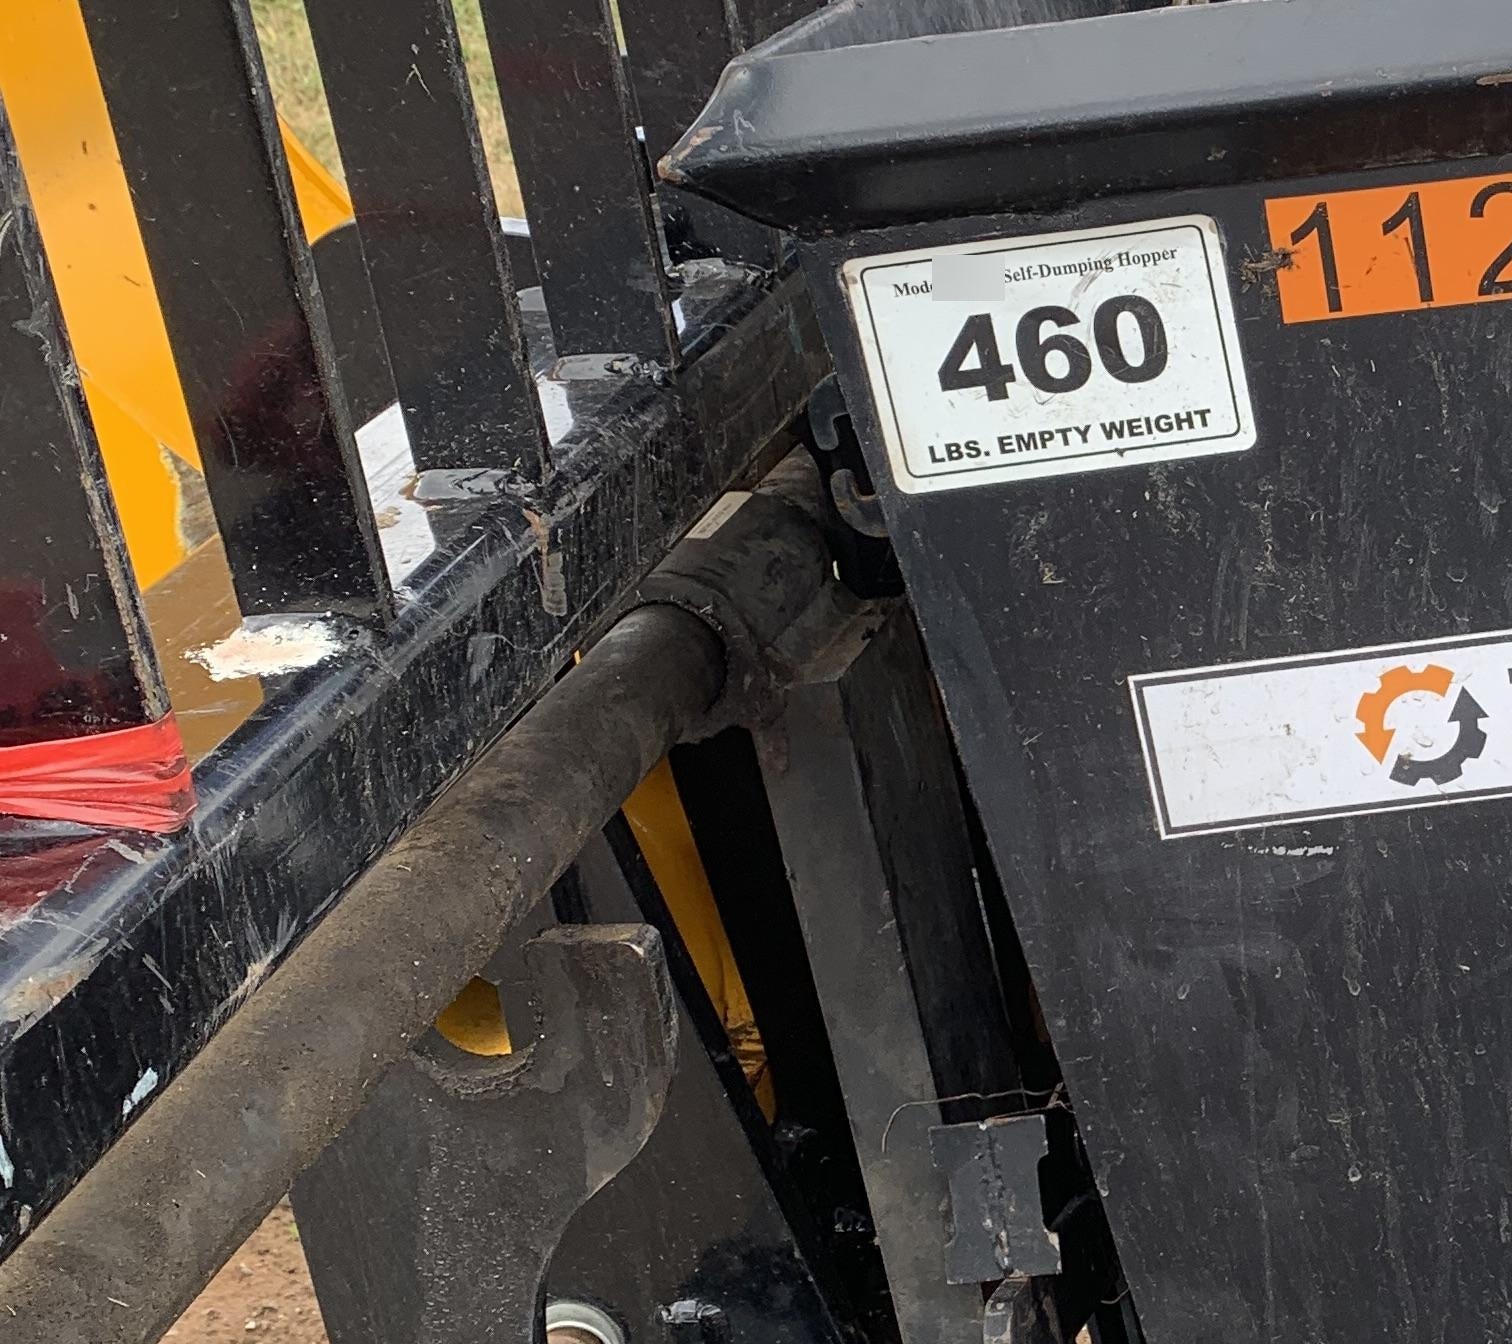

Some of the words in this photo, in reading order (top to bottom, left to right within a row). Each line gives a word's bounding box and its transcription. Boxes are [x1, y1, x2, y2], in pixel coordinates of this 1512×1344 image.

[1005, 257, 1114, 284] Self-Dumping
[1118, 247, 1178, 268] Hopper
[937, 294, 1169, 402] 460
[928, 441, 991, 464] LBS.
[997, 424, 1092, 455] EMPTY
[1099, 408, 1212, 440] WEIGHT
